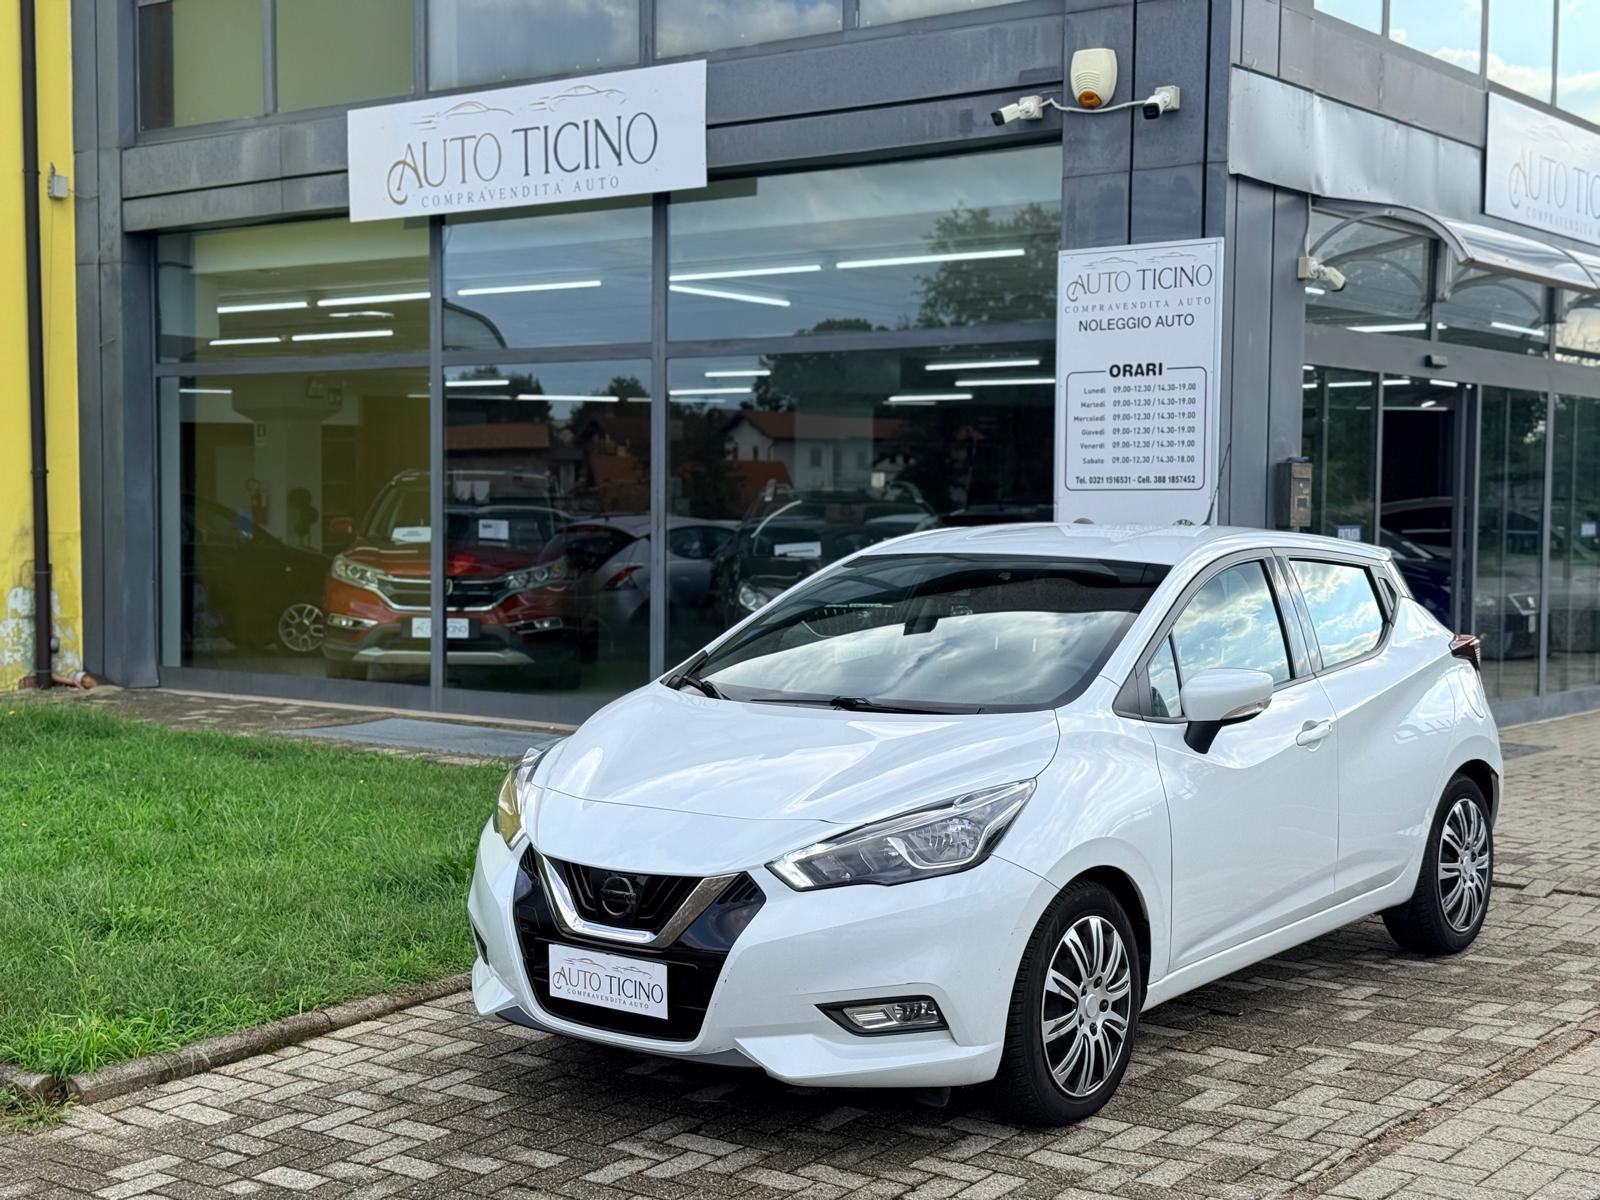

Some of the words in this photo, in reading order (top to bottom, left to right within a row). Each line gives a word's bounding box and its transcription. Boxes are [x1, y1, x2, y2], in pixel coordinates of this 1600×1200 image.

[387, 132, 502, 205] AUTO
[512, 112, 657, 177] TICINO
[421, 183, 562, 208] COMPRAVENDITA
[574, 175, 619, 192] AUTO
[1508, 147, 1568, 209] AUTO
[1066, 270, 1131, 302] AUTO
[1136, 264, 1213, 291] TICINO
[1065, 300, 1170, 314] COMPRAVENDITA
[1178, 296, 1211, 307] AUTO
[1078, 315, 1152, 332] NOLEGGIO
[1155, 313, 1195, 328] AUTO
[1109, 362, 1163, 378] ORARI
[1075, 476, 1087, 484] Tel.
[1088, 476, 1104, 484] 0321
[1137, 476, 1152, 484] Cell.
[1154, 476, 1166, 484] 388
[552, 966, 602, 991] AUTO
[605, 974, 664, 1004] TICINO
[567, 988, 627, 1006] COMPRAVENDITA
[629, 1000, 649, 1009] AUTO
